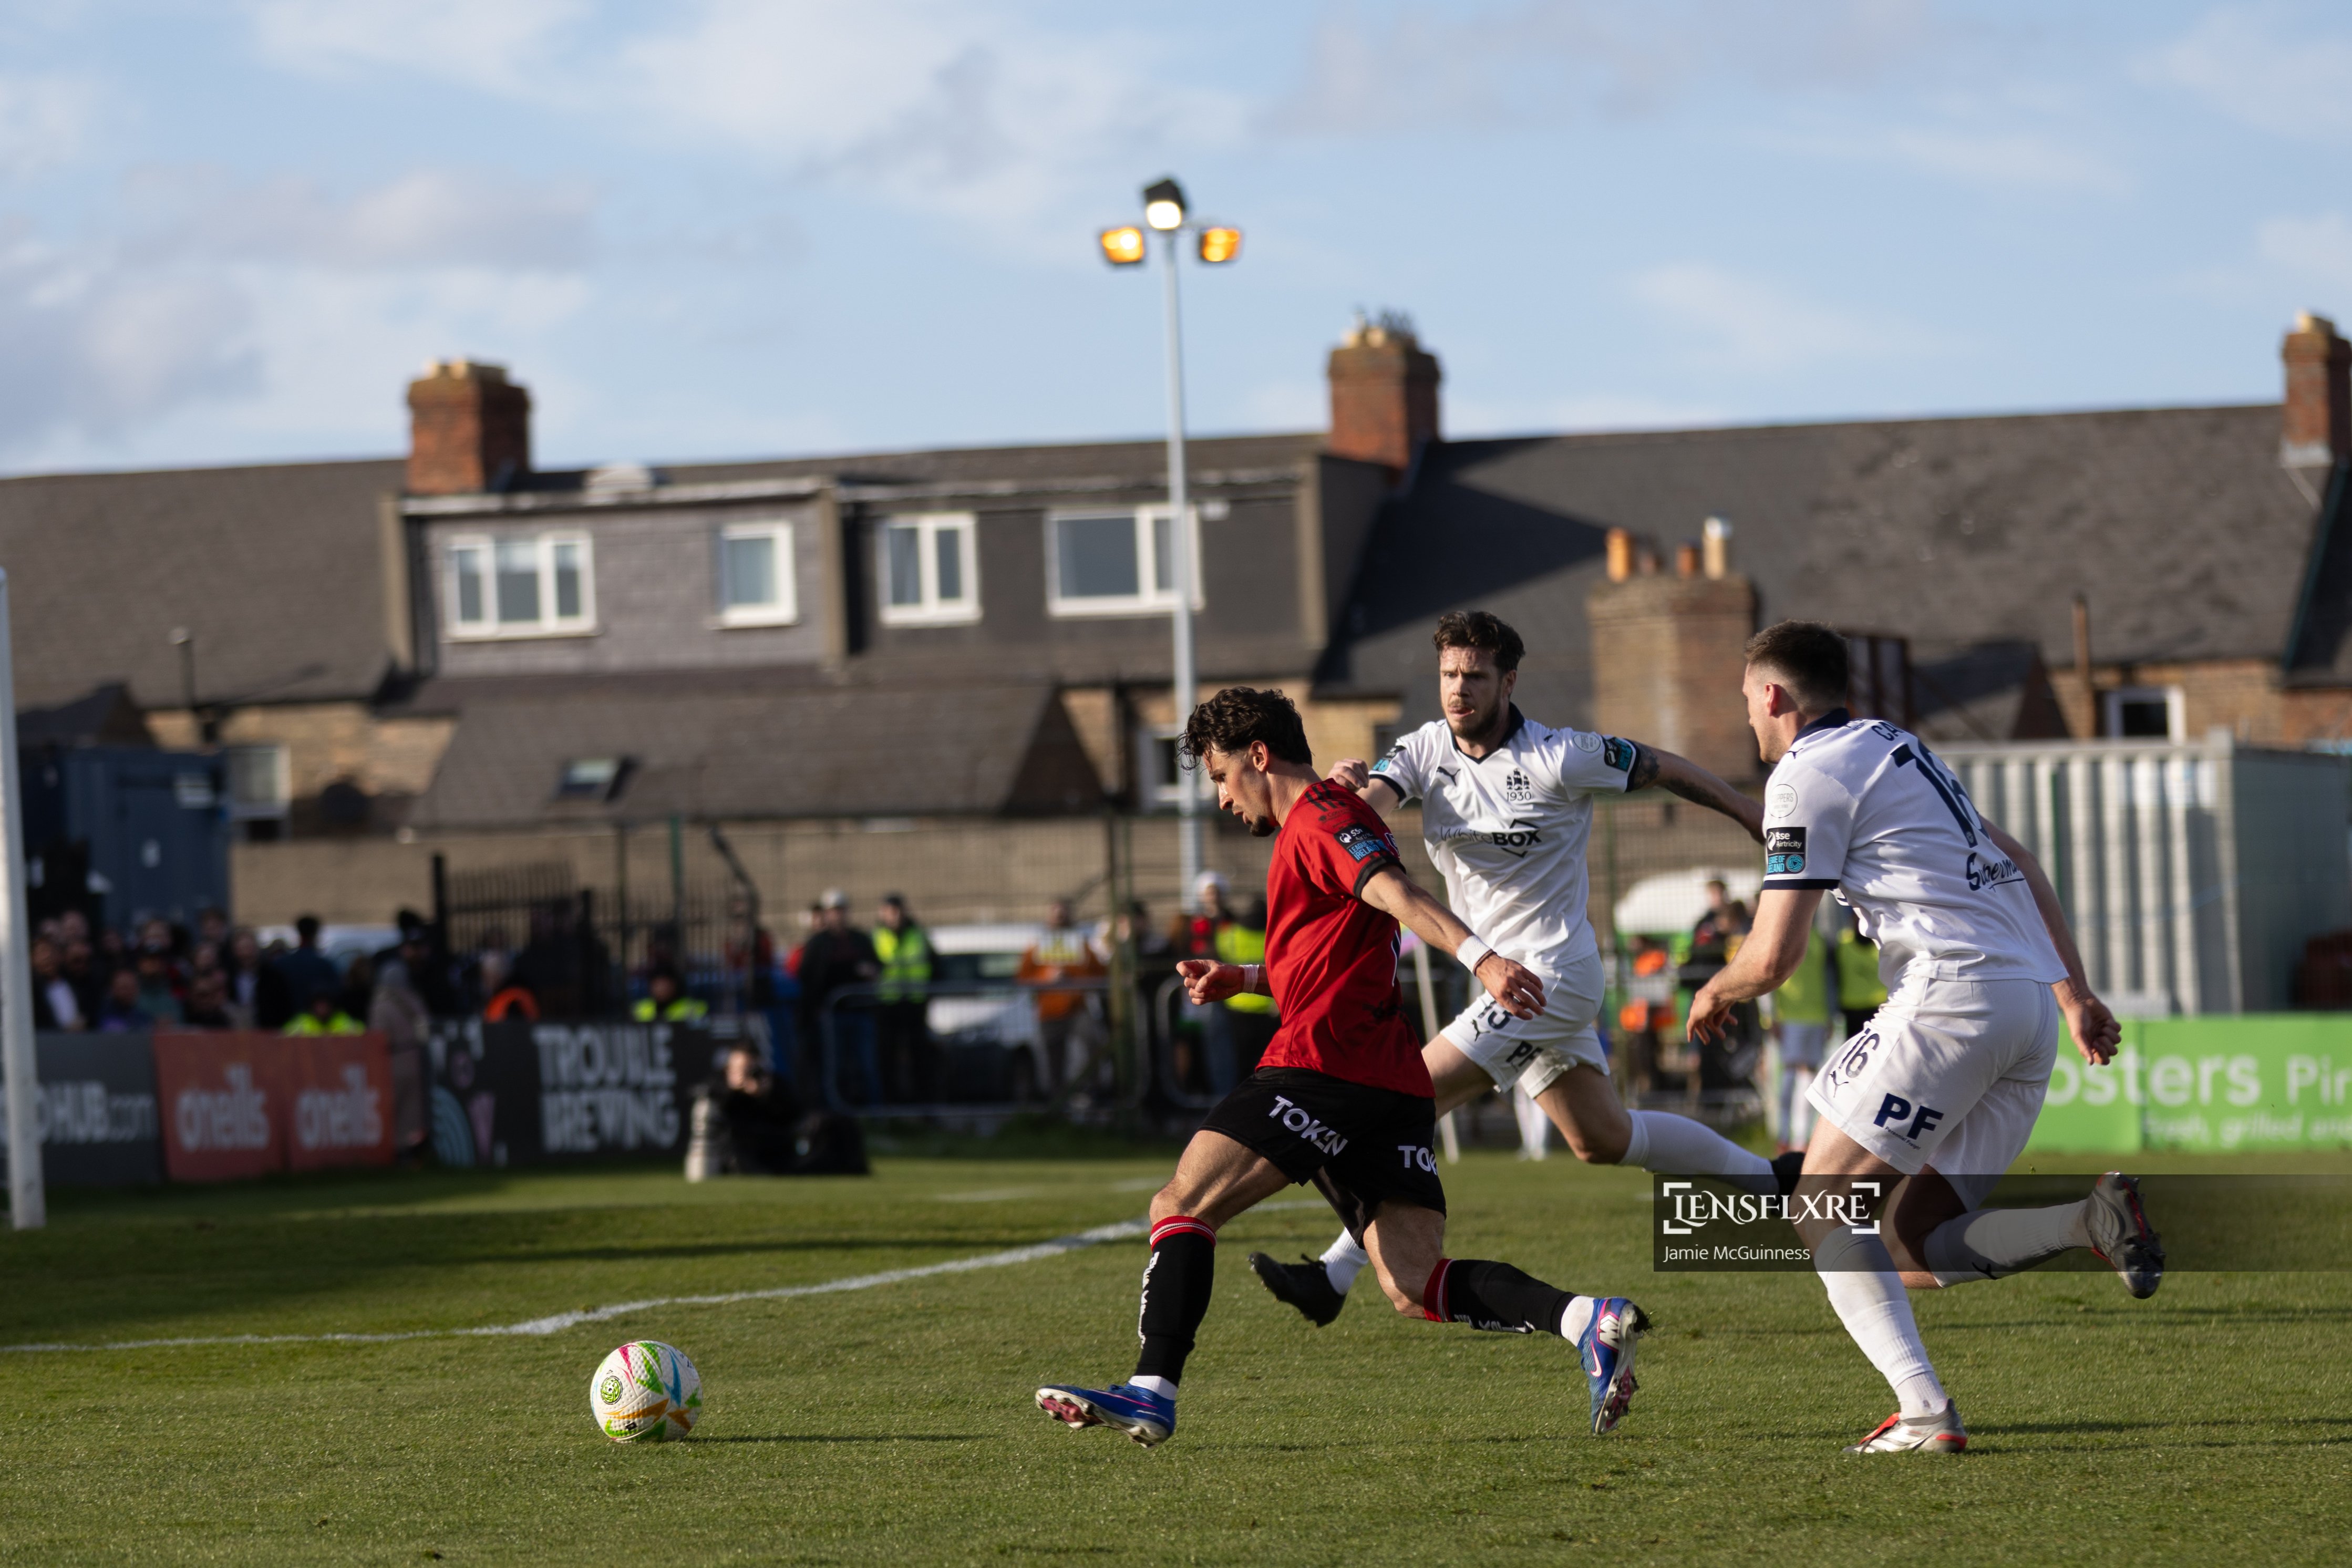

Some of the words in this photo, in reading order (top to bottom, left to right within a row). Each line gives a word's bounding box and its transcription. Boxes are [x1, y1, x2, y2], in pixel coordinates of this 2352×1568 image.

[1507, 791, 1532, 802] 1930
[1348, 840, 1368, 855] LEAGUE
[1353, 845, 1380, 861] IRELAND
[1839, 1027, 1880, 1078] 16
[1268, 1095, 1348, 1157] TOKEN
[1873, 1093, 1944, 1140] PF
